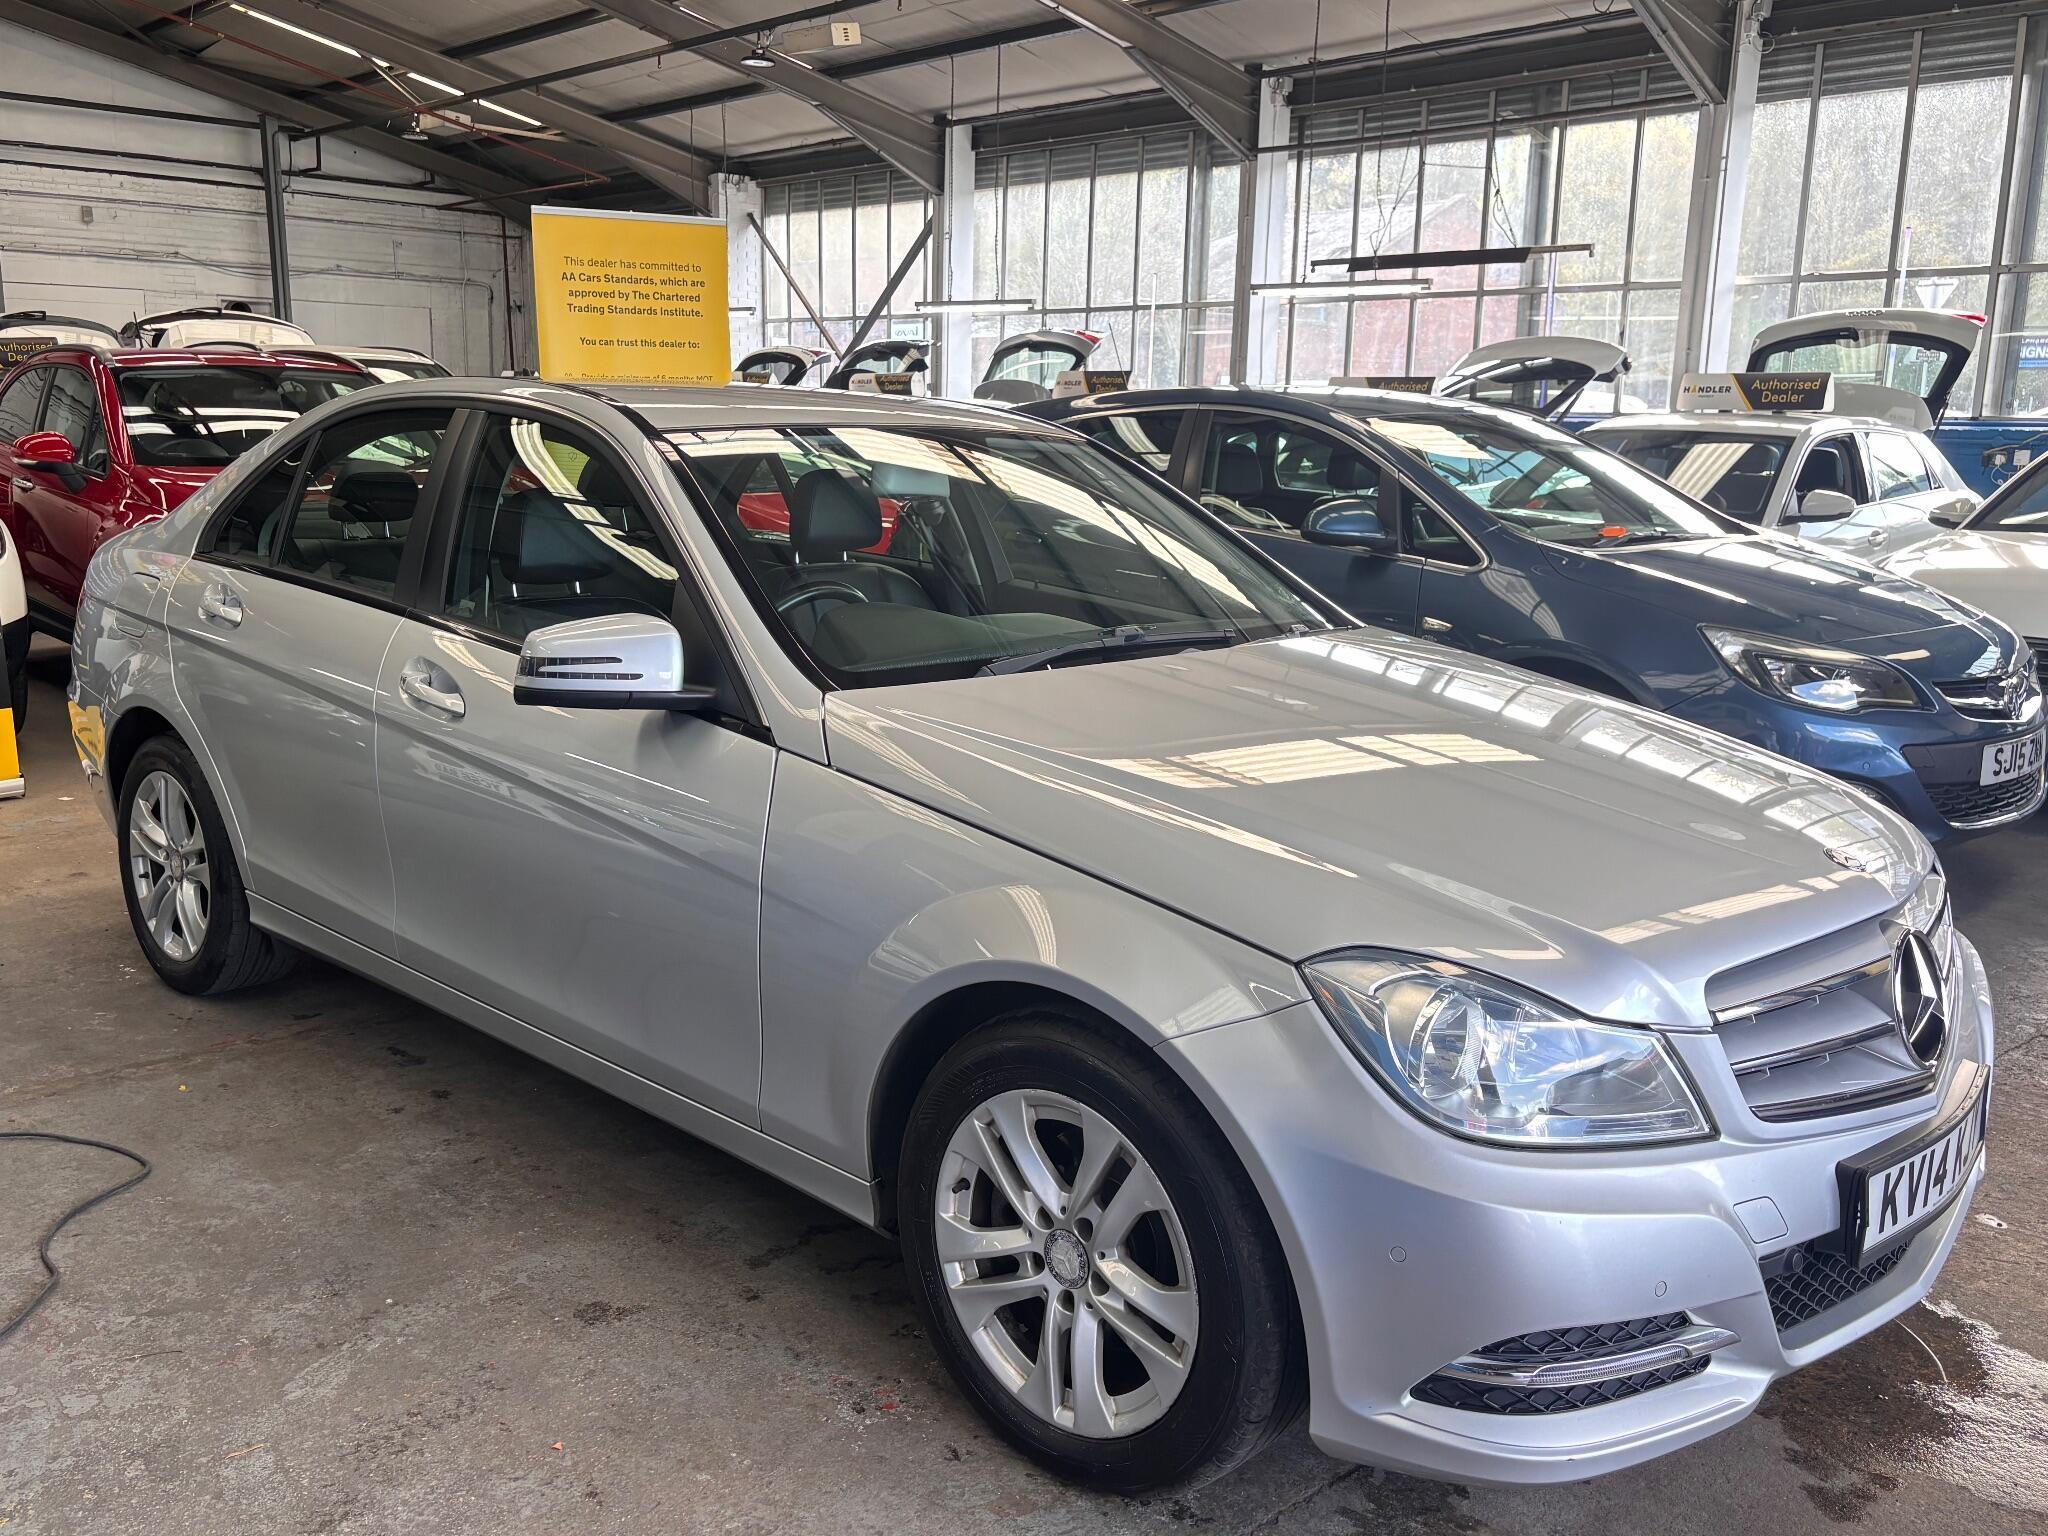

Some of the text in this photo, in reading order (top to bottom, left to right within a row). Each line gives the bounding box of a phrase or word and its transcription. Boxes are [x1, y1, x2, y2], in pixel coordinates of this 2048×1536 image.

[564, 256, 702, 273] This dealer has committed to
[561, 272, 706, 288] AA Cars Standards, which are
[568, 289, 701, 303] approved by The Chartered
[567, 303, 704, 319] Trading Standards Institute.
[580, 337, 701, 350] You can trust this dealer to:
[2020, 345, 2048, 359] IGN
[1379, 380, 1429, 391] Authorised
[1751, 378, 1821, 391] Authorised
[1761, 390, 1804, 403] Dealer
[1993, 742, 2027, 777] SJ15
[1878, 1138, 1951, 1234] KV14
